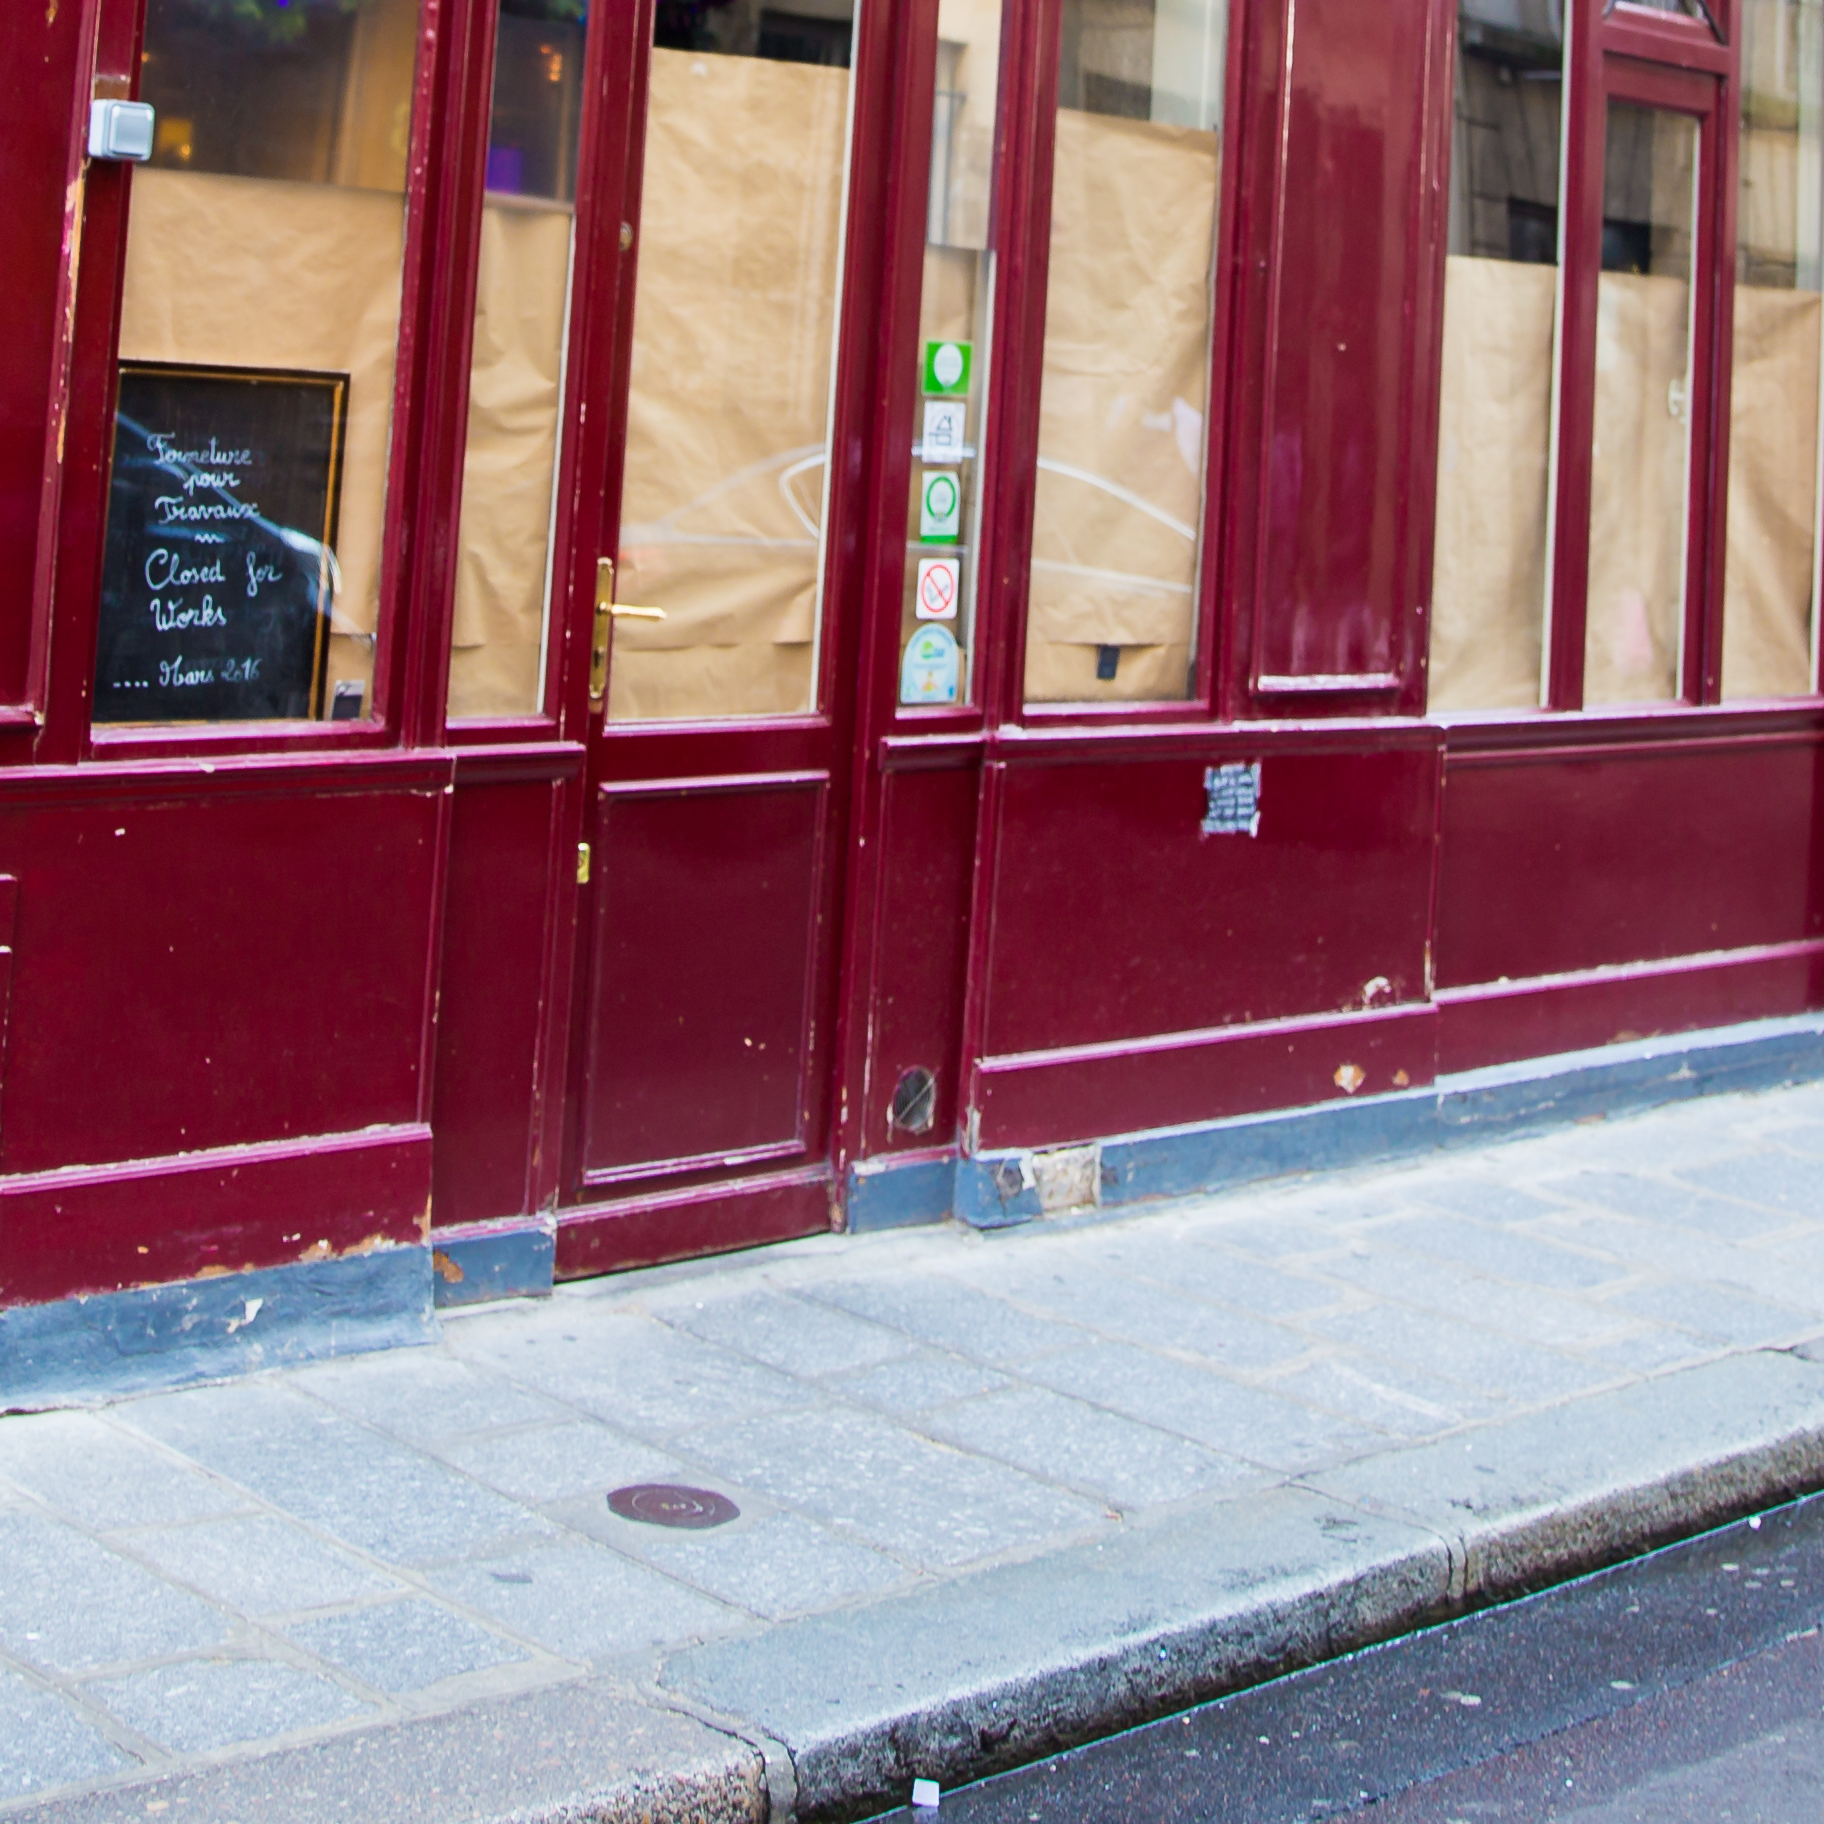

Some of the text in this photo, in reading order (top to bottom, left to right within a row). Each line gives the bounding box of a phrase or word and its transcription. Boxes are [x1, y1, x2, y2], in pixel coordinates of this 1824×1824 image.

[146, 431, 253, 466] Fermeture
[182, 470, 241, 498] pour
[154, 495, 262, 526] Travaux
[144, 547, 283, 597] Closed for
[149, 593, 228, 632] Works
[158, 654, 215, 688] Mars
